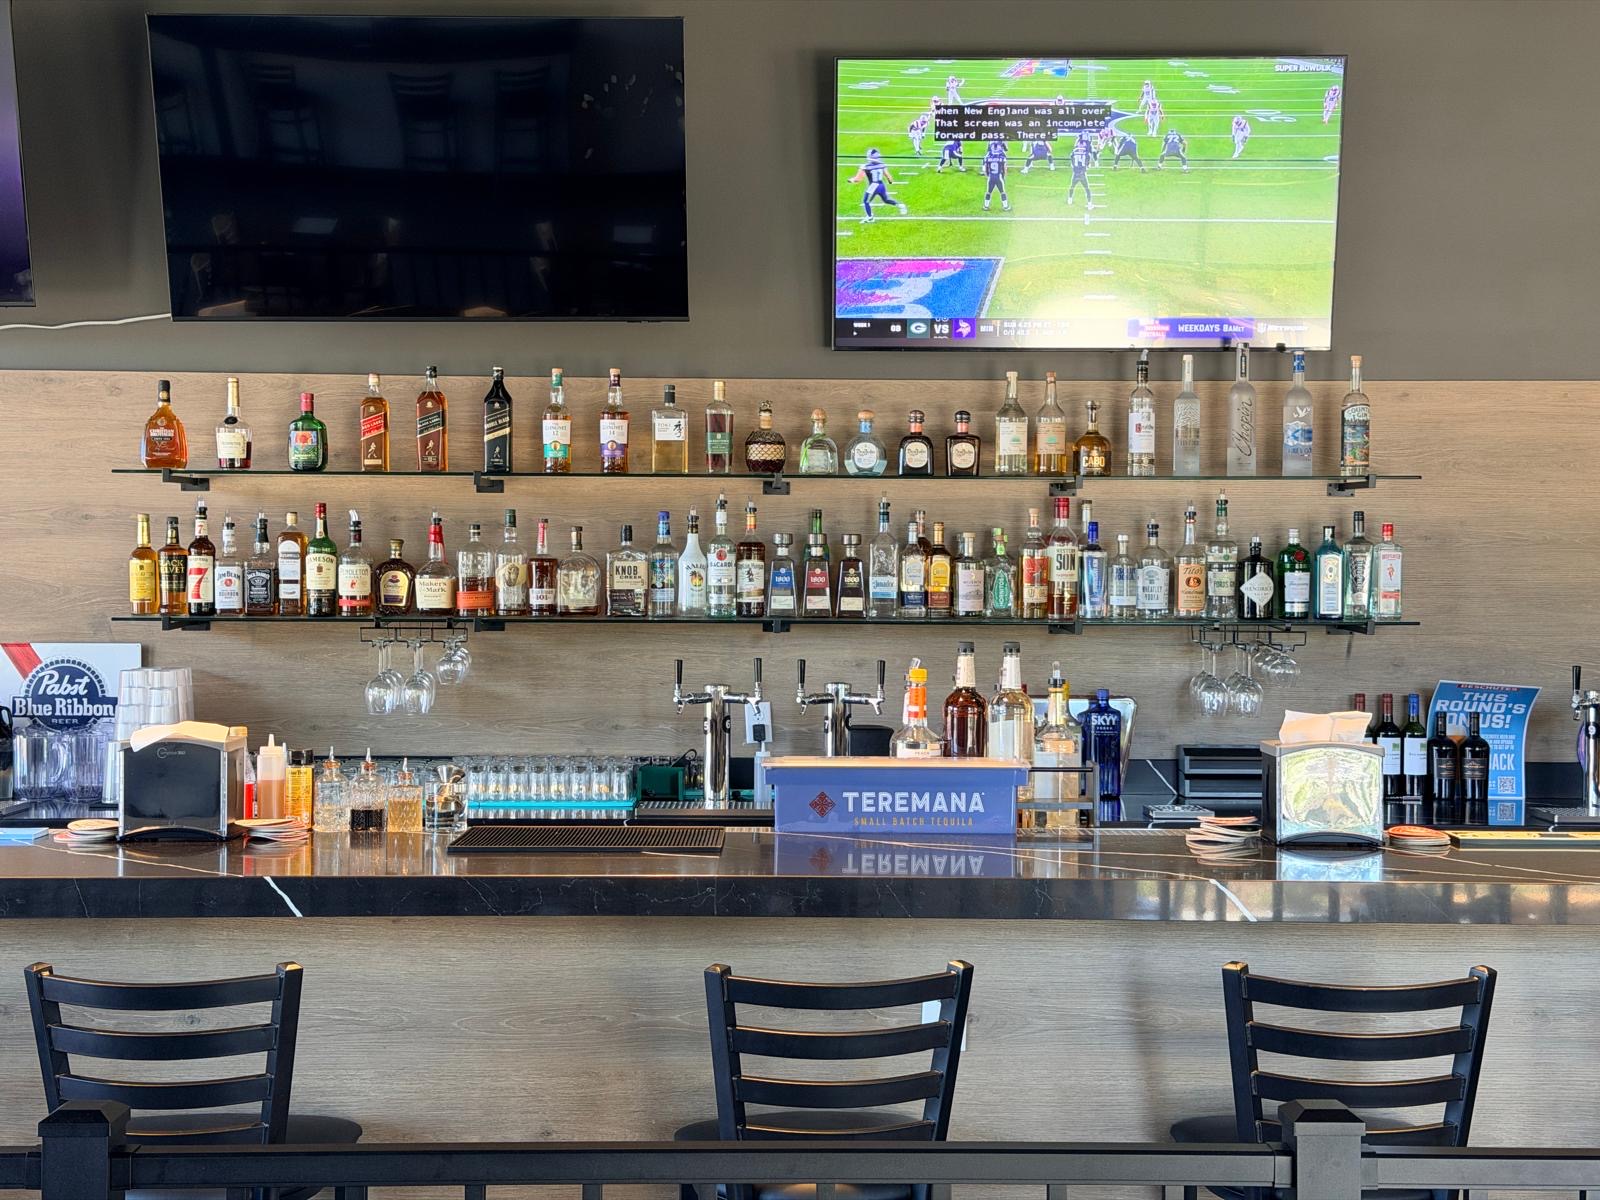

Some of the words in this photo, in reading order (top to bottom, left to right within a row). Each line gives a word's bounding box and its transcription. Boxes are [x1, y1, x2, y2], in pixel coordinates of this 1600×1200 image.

[1274, 64, 1298, 72] SUPER
[935, 107, 958, 115] when
[964, 107, 982, 115] New
[988, 107, 1029, 116] England
[1058, 107, 1076, 115] all
[935, 119, 958, 127] That
[1046, 119, 1106, 129] incomplete
[935, 131, 976, 140] forward
[982, 132, 1010, 140] pass.
[1016, 131, 1058, 140] There's
[1074, 155, 1086, 167] 14
[990, 162, 998, 174] 9
[934, 324, 950, 334] VS
[1178, 324, 1220, 332] WEEKDAYS
[1232, 398, 1253, 457] Chopin
[1082, 456, 1105, 468] CABO
[197, 525, 204, 534] 7
[1056, 553, 1076, 570] SON
[615, 566, 638, 576] KNOB
[1183, 566, 1203, 575] Tito's
[189, 568, 208, 599] 7
[38, 669, 91, 696] Pabst
[1462, 692, 1508, 702] THIS
[14, 698, 52, 716] Blue
[55, 698, 114, 716] Ribbon
[1436, 700, 1526, 714] ROUND'S
[1091, 714, 1117, 725] SKYY
[1446, 712, 1470, 728] ON
[1480, 714, 1512, 728] US!
[1489, 753, 1515, 770] ACK
[842, 792, 985, 812] TEREMANA
[853, 817, 886, 826] SMALL
[892, 817, 925, 826] BATCH
[931, 817, 973, 826] TEQUILA
